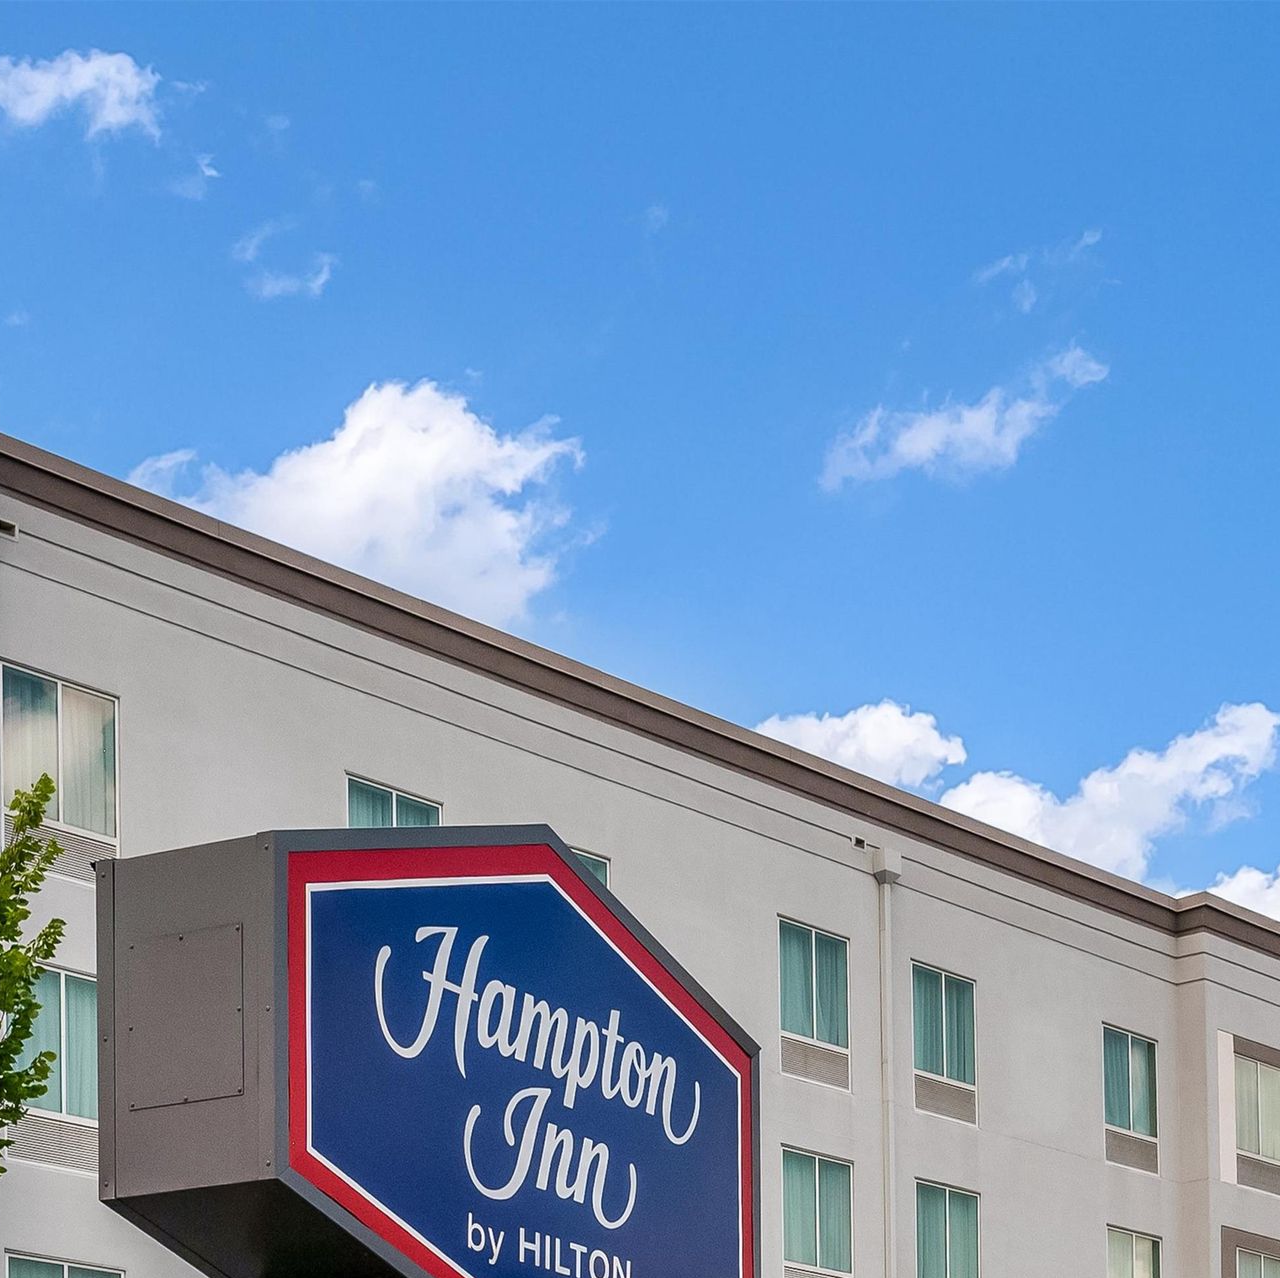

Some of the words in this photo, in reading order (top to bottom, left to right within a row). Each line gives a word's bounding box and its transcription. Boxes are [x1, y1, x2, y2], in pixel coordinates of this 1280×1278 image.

[375, 926, 700, 1145] Hampton
[464, 1087, 636, 1229] Inn
[467, 1213, 504, 1265] by
